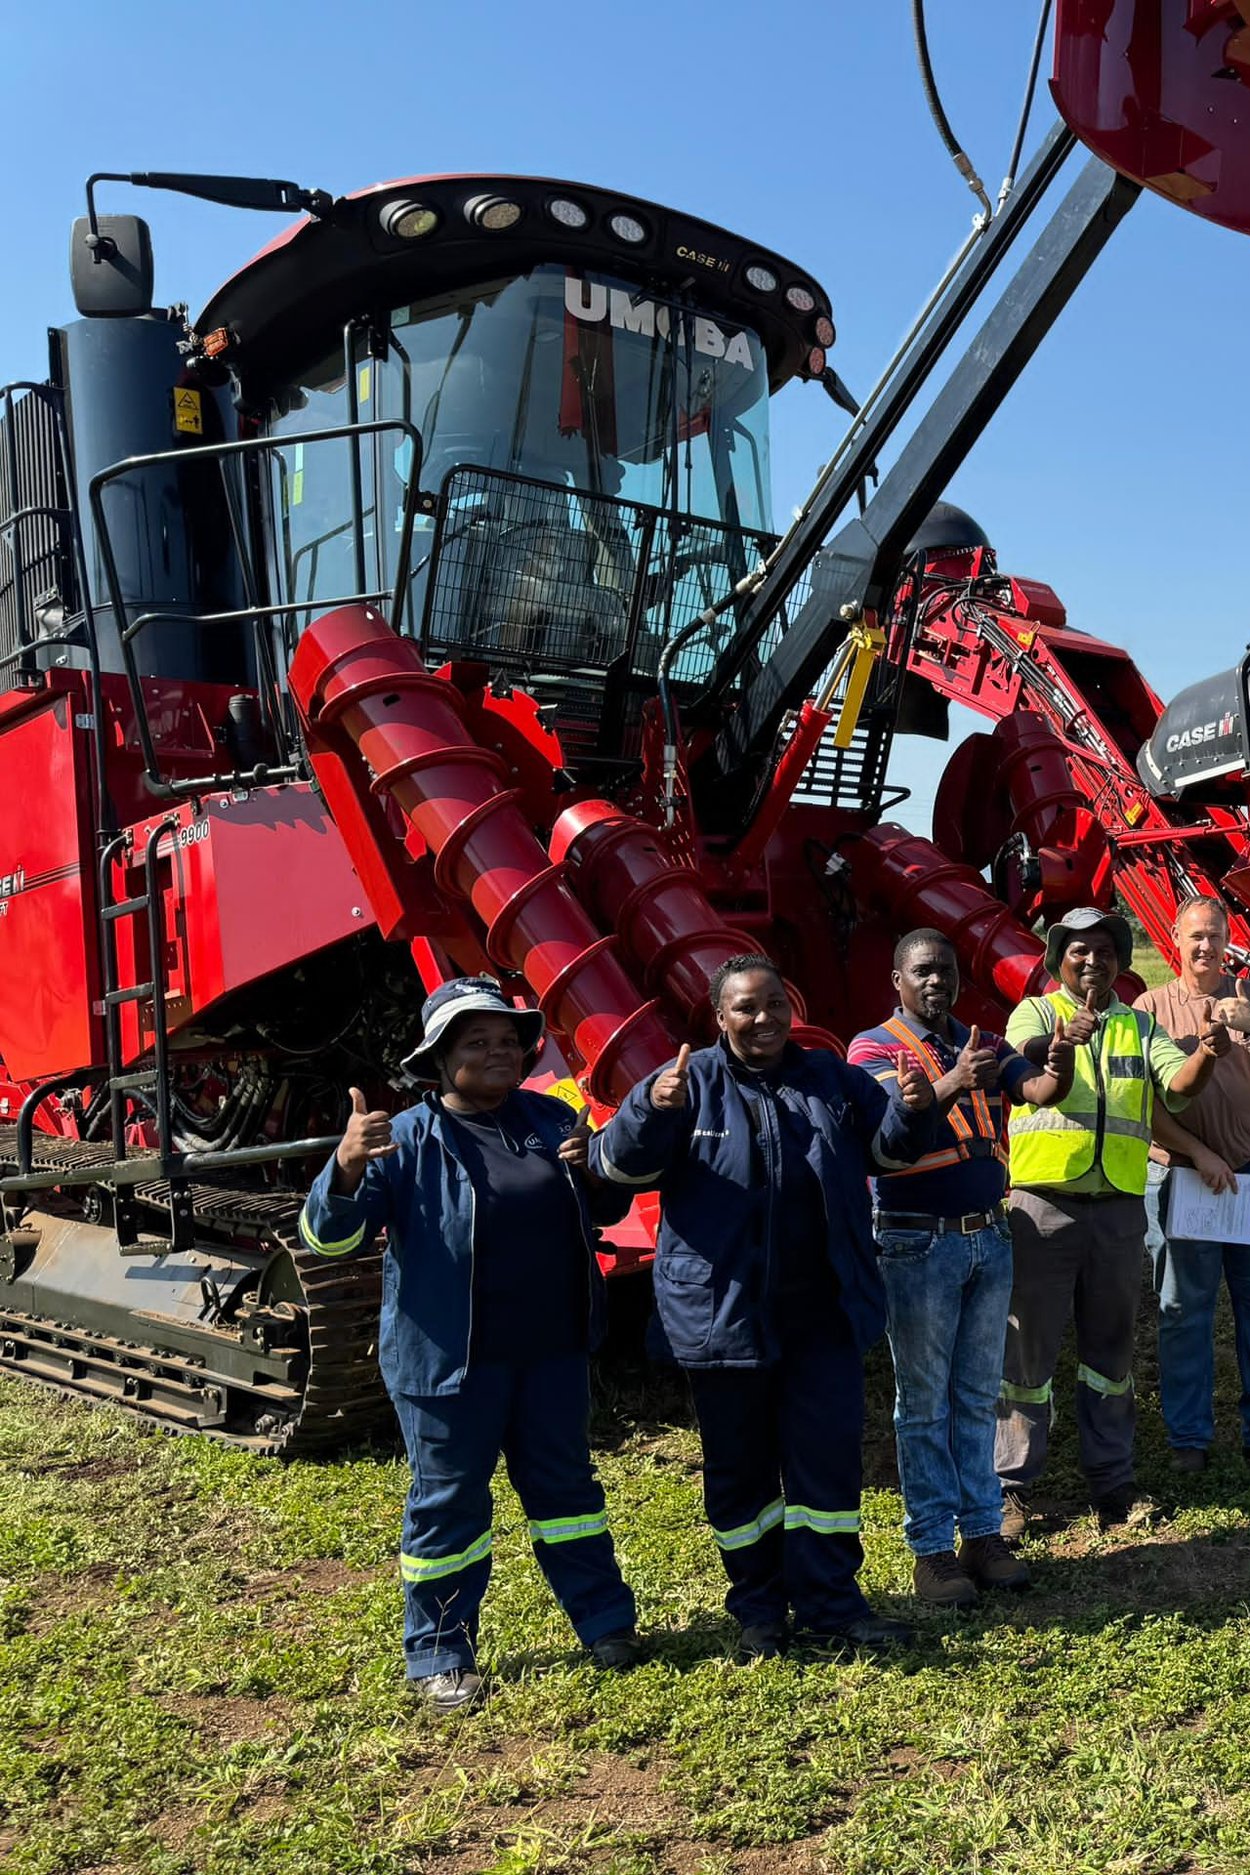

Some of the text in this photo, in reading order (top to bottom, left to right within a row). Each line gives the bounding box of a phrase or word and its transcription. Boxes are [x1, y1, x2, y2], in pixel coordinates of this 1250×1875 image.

[676, 246, 717, 268] CASE
[1166, 722, 1217, 753] CASE
[178, 819, 211, 849] 9900
